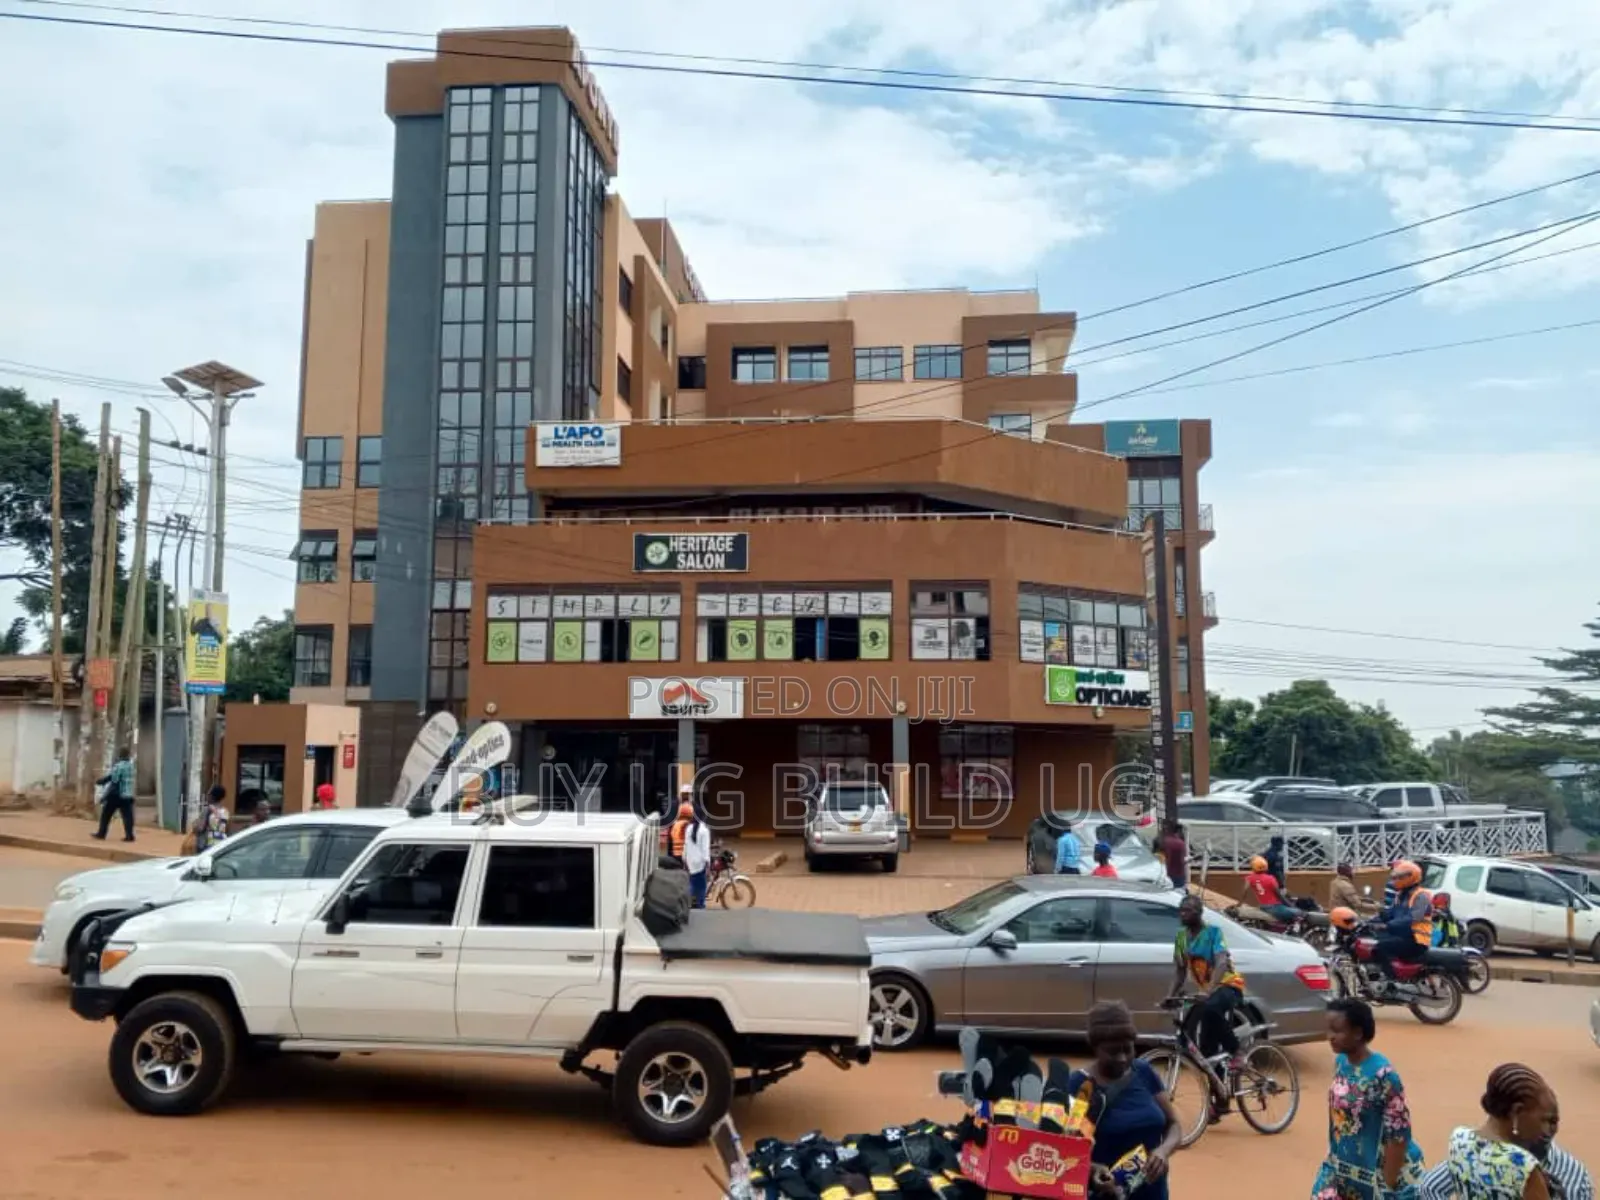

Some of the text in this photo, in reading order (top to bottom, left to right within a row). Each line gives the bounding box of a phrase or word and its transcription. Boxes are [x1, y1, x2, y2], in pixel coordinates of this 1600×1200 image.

[554, 426, 603, 439] L'APO
[669, 536, 734, 552] HERITAGE
[677, 553, 725, 569] SALON
[1076, 686, 1152, 706] OPTICIANS
[1022, 1156, 1061, 1173] Goldy
